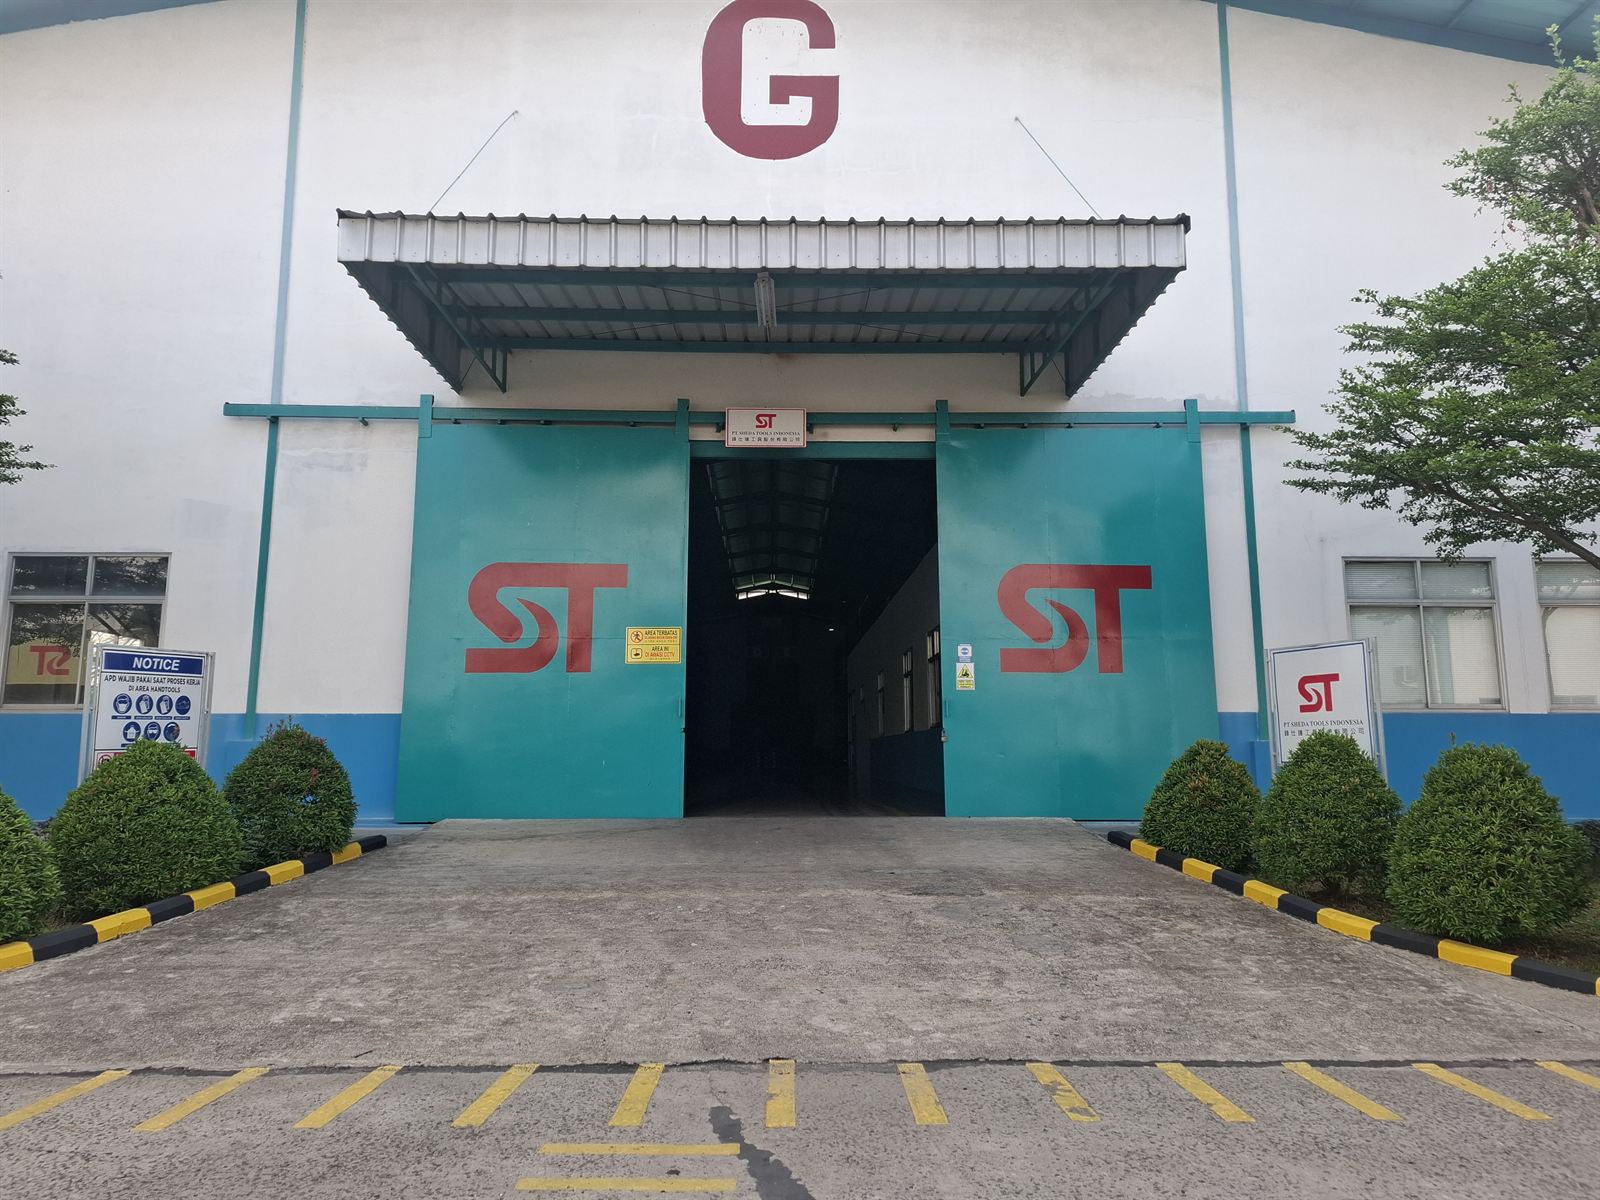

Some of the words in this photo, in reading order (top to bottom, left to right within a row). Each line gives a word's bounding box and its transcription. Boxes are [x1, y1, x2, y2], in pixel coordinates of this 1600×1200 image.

[702, 0, 839, 160] G
[756, 413, 777, 428] ST
[465, 562, 628, 673] ST
[997, 563, 1152, 673] ST
[132, 657, 180, 671] NOTICE
[104, 674, 117, 682] APD
[117, 675, 135, 683] WAJIB
[136, 676, 152, 684] PAKAI
[153, 676, 166, 684] SAAT
[167, 677, 186, 685] PROSES
[186, 678, 201, 686] KERJA
[1297, 673, 1340, 713] ST
[1330, 719, 1364, 727] INDONESIA
